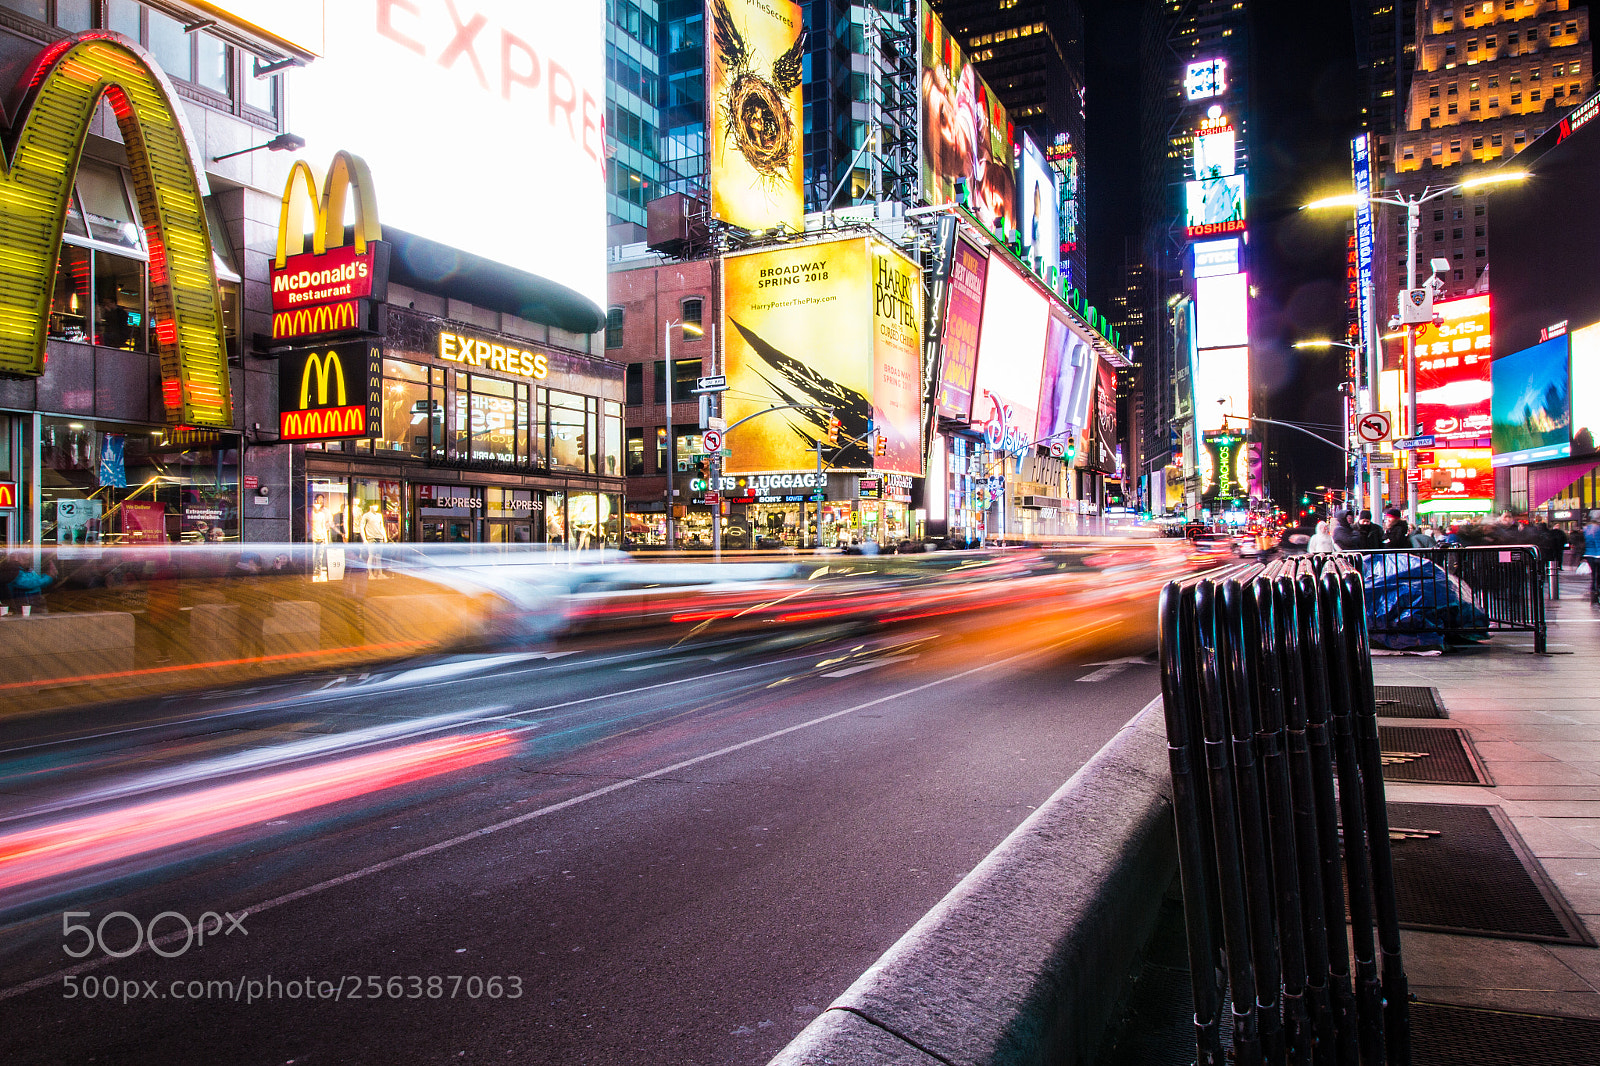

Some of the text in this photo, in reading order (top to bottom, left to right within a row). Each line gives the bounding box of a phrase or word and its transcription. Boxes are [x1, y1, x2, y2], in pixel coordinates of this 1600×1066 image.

[1571, 105, 1600, 132] MARQUIS
[1195, 125, 1234, 137] TOSHIBA
[1187, 220, 1246, 236] TOSHIBA
[273, 261, 368, 293] McDonald's
[758, 271, 829, 289] SPRING 2018
[760, 261, 827, 278] BROADWAY
[878, 255, 915, 304] HARRY
[1348, 235, 1357, 309] ERNST
[288, 284, 351, 303] Restaurant
[750, 295, 837, 311] HarryPotterThePlay.com
[875, 283, 918, 333] POTTER
[1048, 264, 1121, 350] BROADWAY
[950, 313, 978, 346] COME
[439, 331, 548, 380] EXPRESS
[943, 359, 974, 391] AWAY
[986, 389, 1030, 475] Disney
[747, 473, 828, 488] LUGGAGE
[1219, 446, 1229, 497] PISTACHIOS
[62, 504, 75, 514] $2
[185, 508, 223, 516] Extraordinary
[437, 496, 482, 509] EXPRESS
[504, 499, 543, 511] EXPRESS
